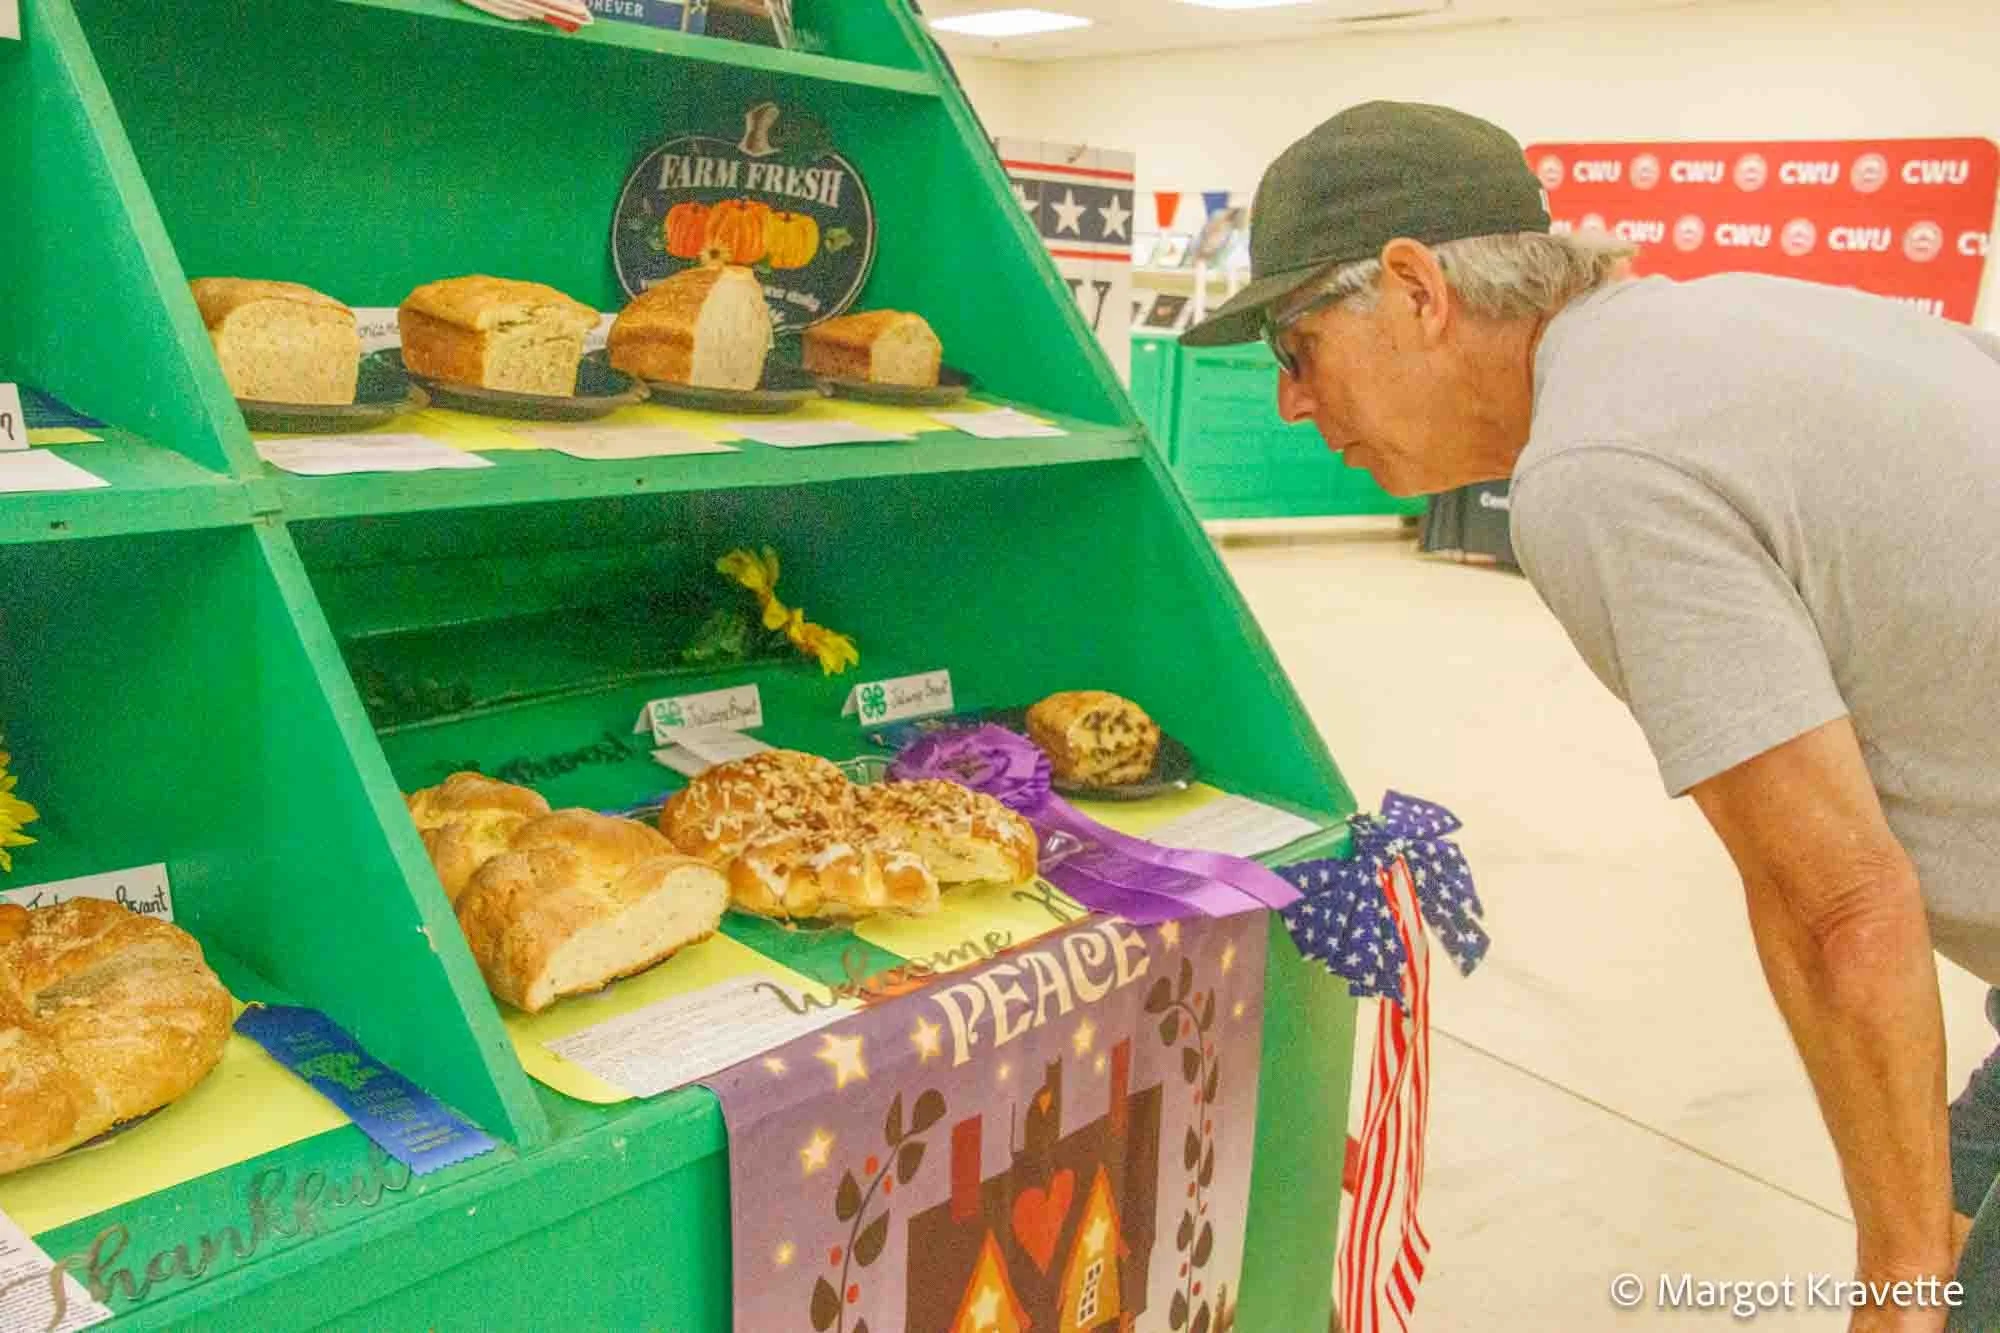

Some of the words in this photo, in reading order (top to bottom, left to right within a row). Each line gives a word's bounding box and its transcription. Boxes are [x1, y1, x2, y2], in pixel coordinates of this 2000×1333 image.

[657, 153, 740, 190] FARM
[744, 161, 845, 208] FRESH
[1573, 160, 1622, 183] CWU
[1670, 160, 1725, 184] CWU
[1779, 160, 1840, 185] CWU
[1902, 159, 1969, 185] CWU
[1615, 220, 1665, 244] CWU
[1714, 223, 1772, 248] CWU
[1828, 226, 1892, 251] CWU
[930, 916, 1151, 1068] PEACE
